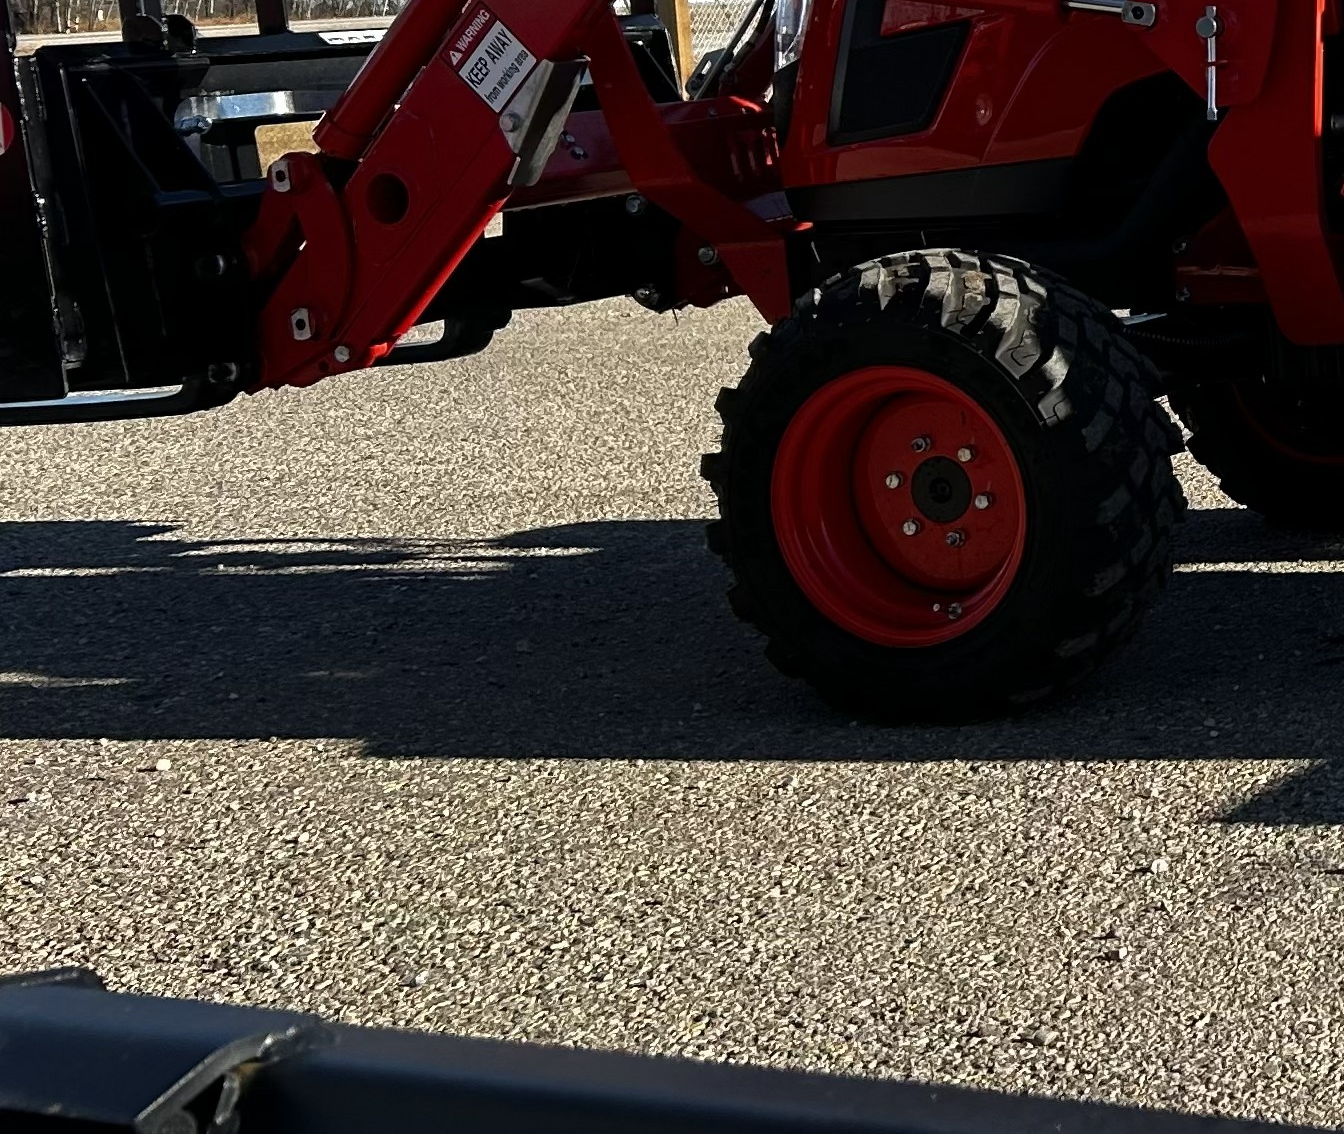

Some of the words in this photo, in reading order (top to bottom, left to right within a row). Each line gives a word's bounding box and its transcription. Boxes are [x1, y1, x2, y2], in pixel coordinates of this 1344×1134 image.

[455, 9, 490, 52] WARNING
[465, 56, 490, 89] KEEP
[484, 28, 512, 64] AWAY
[484, 86, 502, 104] from
[496, 62, 520, 90] working
[514, 49, 529, 66] area
